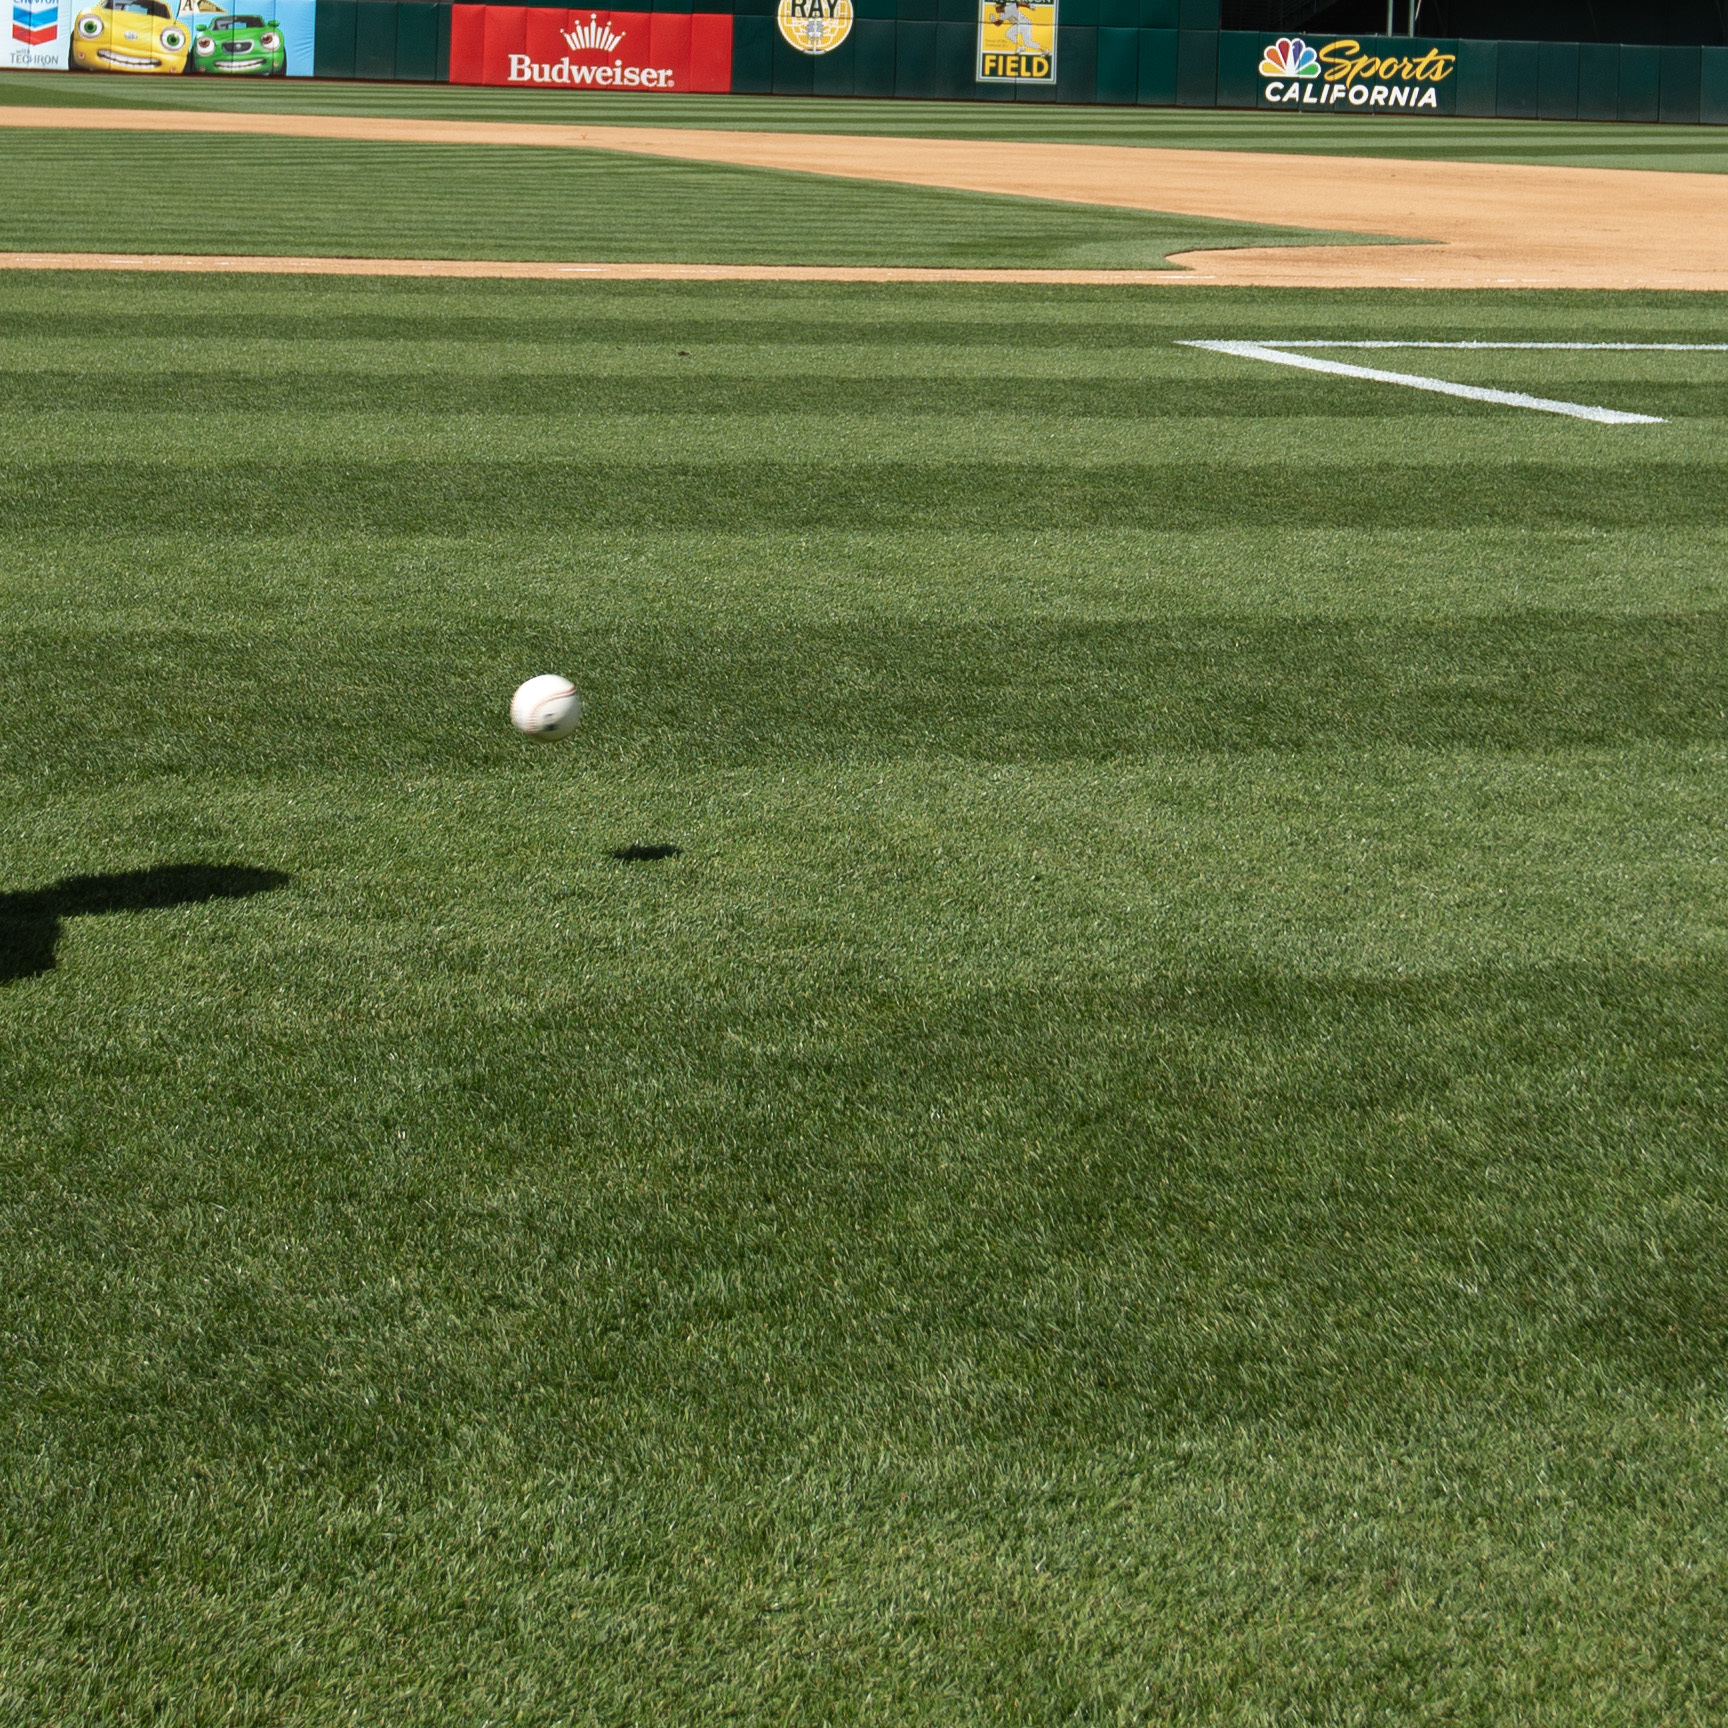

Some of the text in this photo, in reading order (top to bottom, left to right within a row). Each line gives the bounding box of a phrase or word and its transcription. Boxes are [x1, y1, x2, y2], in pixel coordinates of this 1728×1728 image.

[507, 53, 674, 88] Budweiser
[984, 55, 1049, 77] FIELD
[1319, 39, 1456, 89] Sports
[1265, 81, 1438, 108] CALIFORNIA
